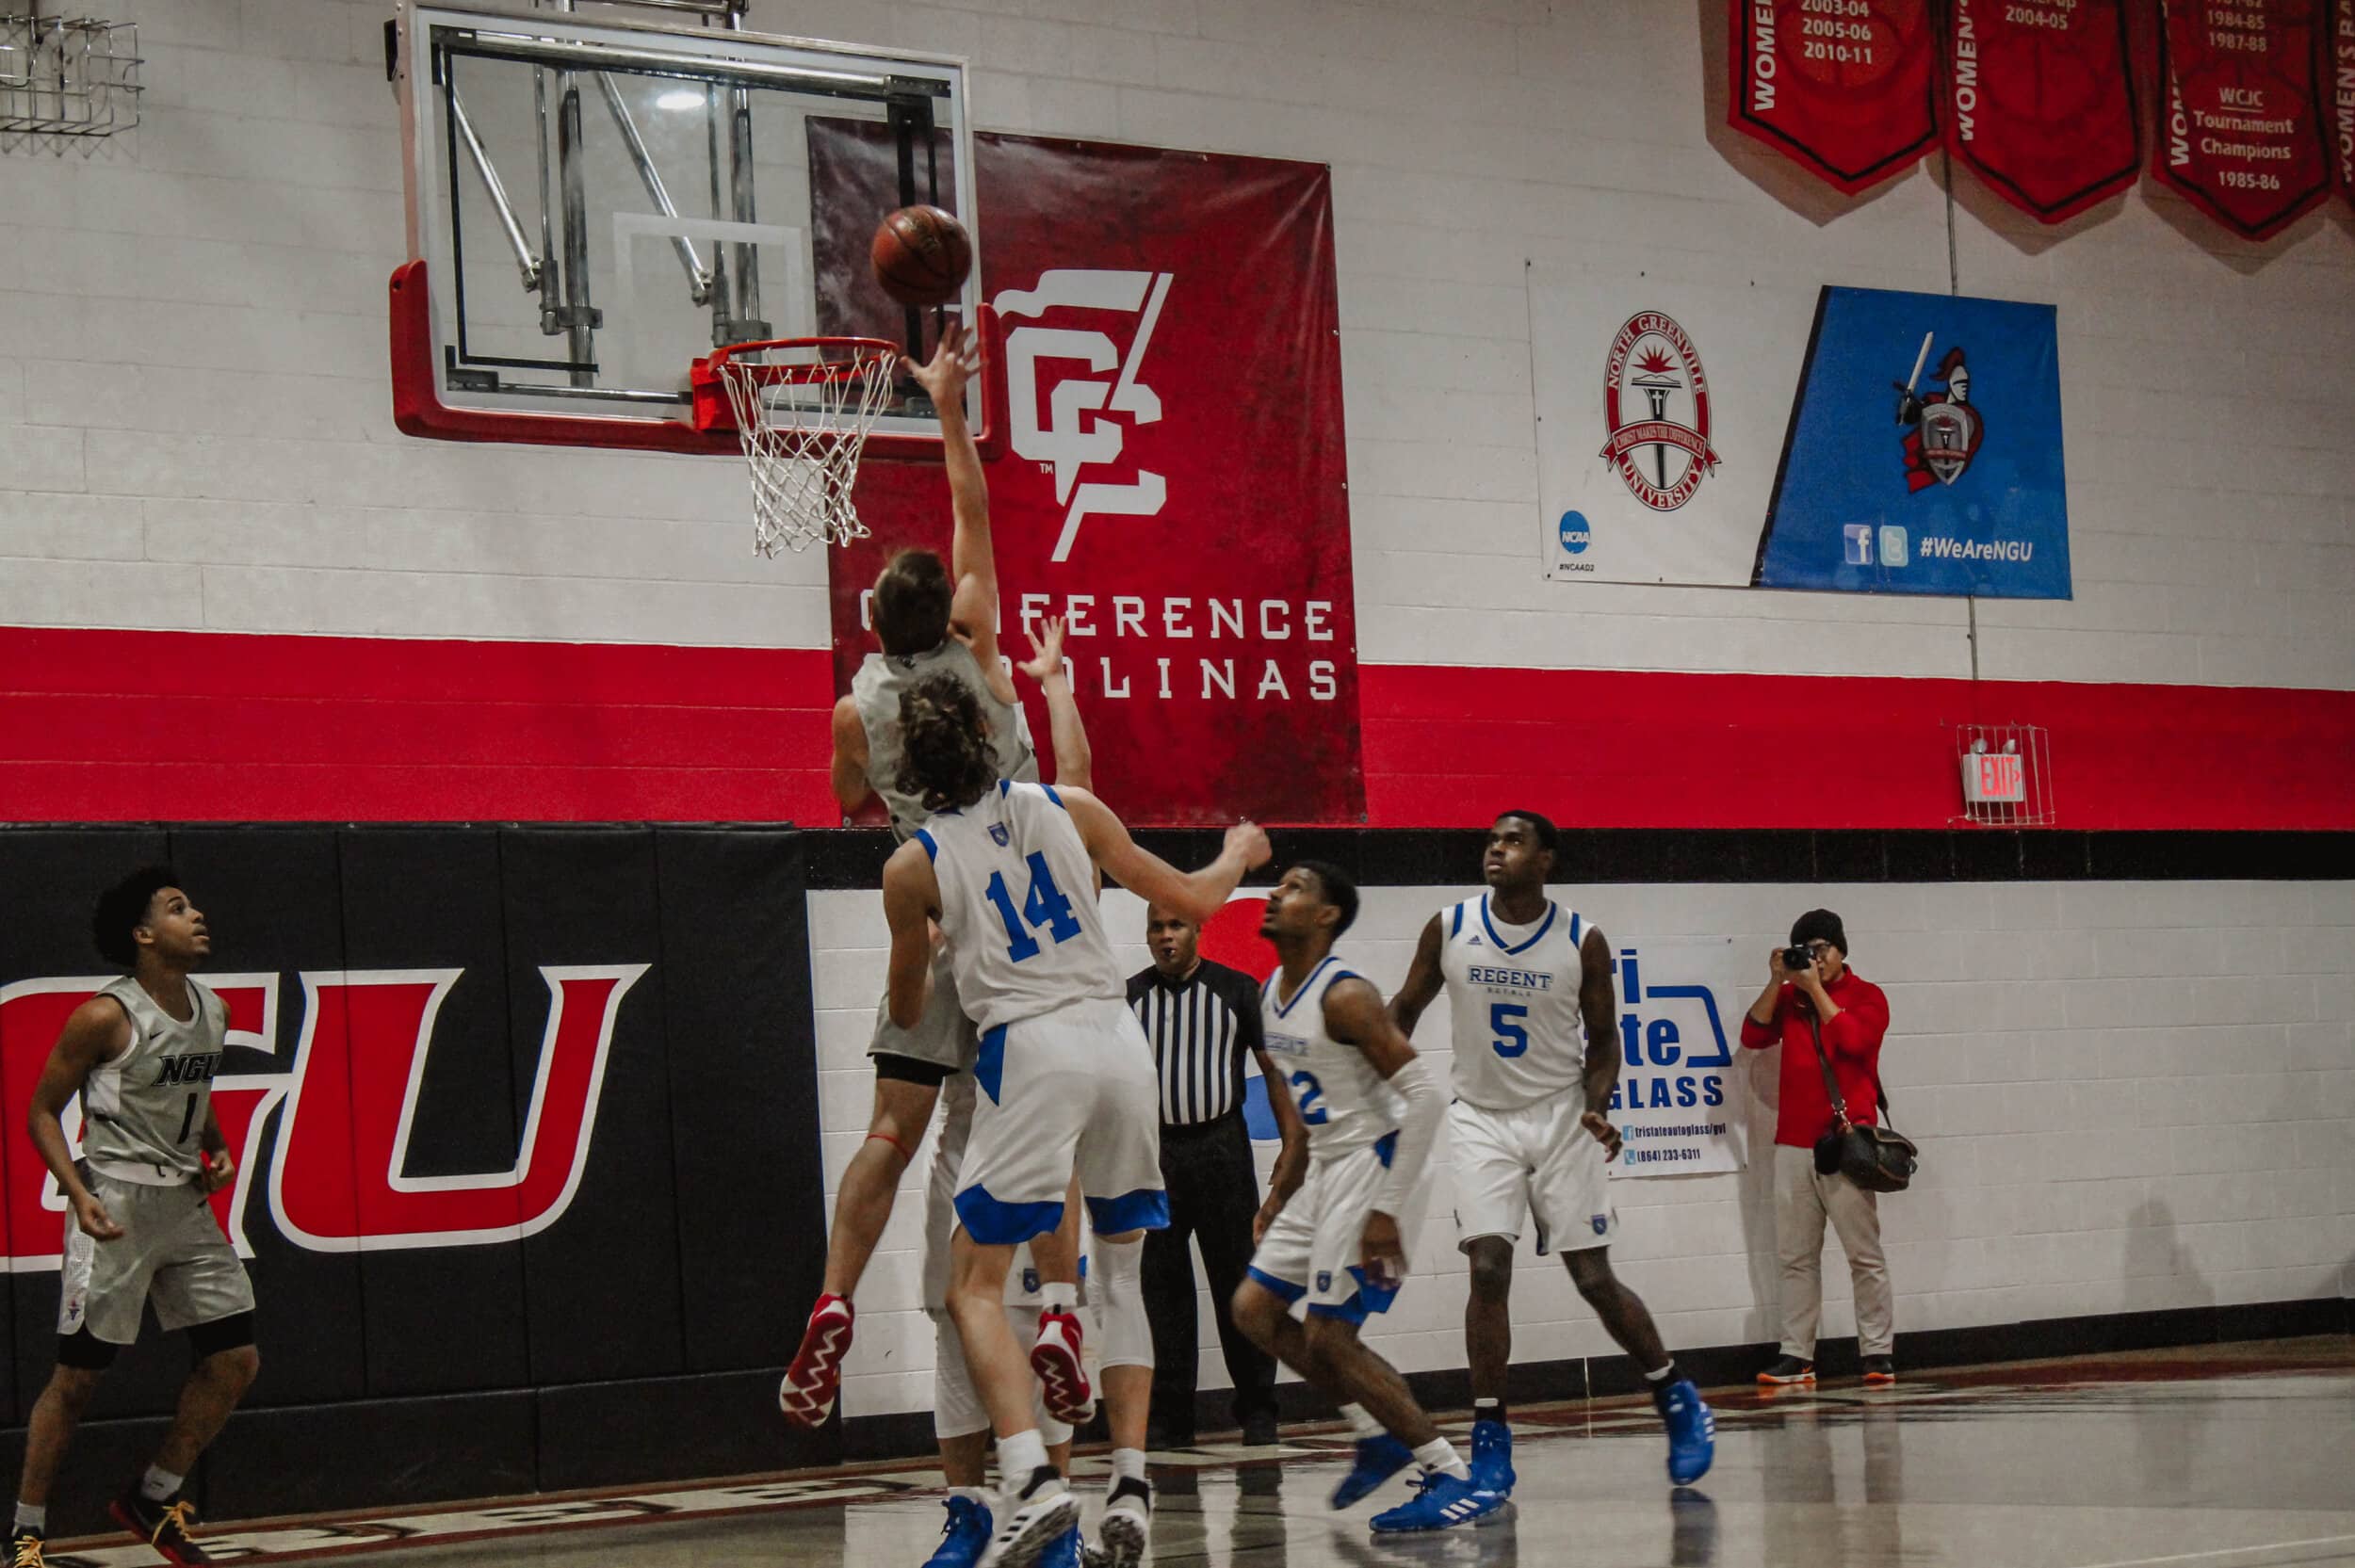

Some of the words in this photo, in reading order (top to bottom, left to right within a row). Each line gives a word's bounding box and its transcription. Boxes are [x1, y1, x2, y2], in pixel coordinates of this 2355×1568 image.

[1802, 17, 1872, 40] 2005-06
[2006, 5, 2069, 30] 2004-05
[1754, 0, 1776, 111] WOME
[1804, 41, 1872, 64] 2010-11
[2219, 88, 2264, 106] WCJC
[2193, 109, 2294, 134] Tournament
[2201, 138, 2292, 162] Champions
[2218, 171, 2280, 190] 1985-86
[1608, 327, 1635, 390] NORTH
[1638, 315, 1705, 393] GREENVILLE
[1623, 461, 1701, 507] UNIVERSITY
[1920, 537, 2033, 561] #WeAreNGU
[1980, 756, 2016, 797] EXIT
[985, 851, 1082, 963] 14
[1469, 967, 1552, 990] REGENT
[1490, 1003, 1528, 1059] 5
[1291, 1070, 1327, 1125] 2
[177, 1092, 198, 1144] 1
[1637, 1150, 1661, 1163] (864)
[1663, 1148, 1701, 1162] 233-6311
